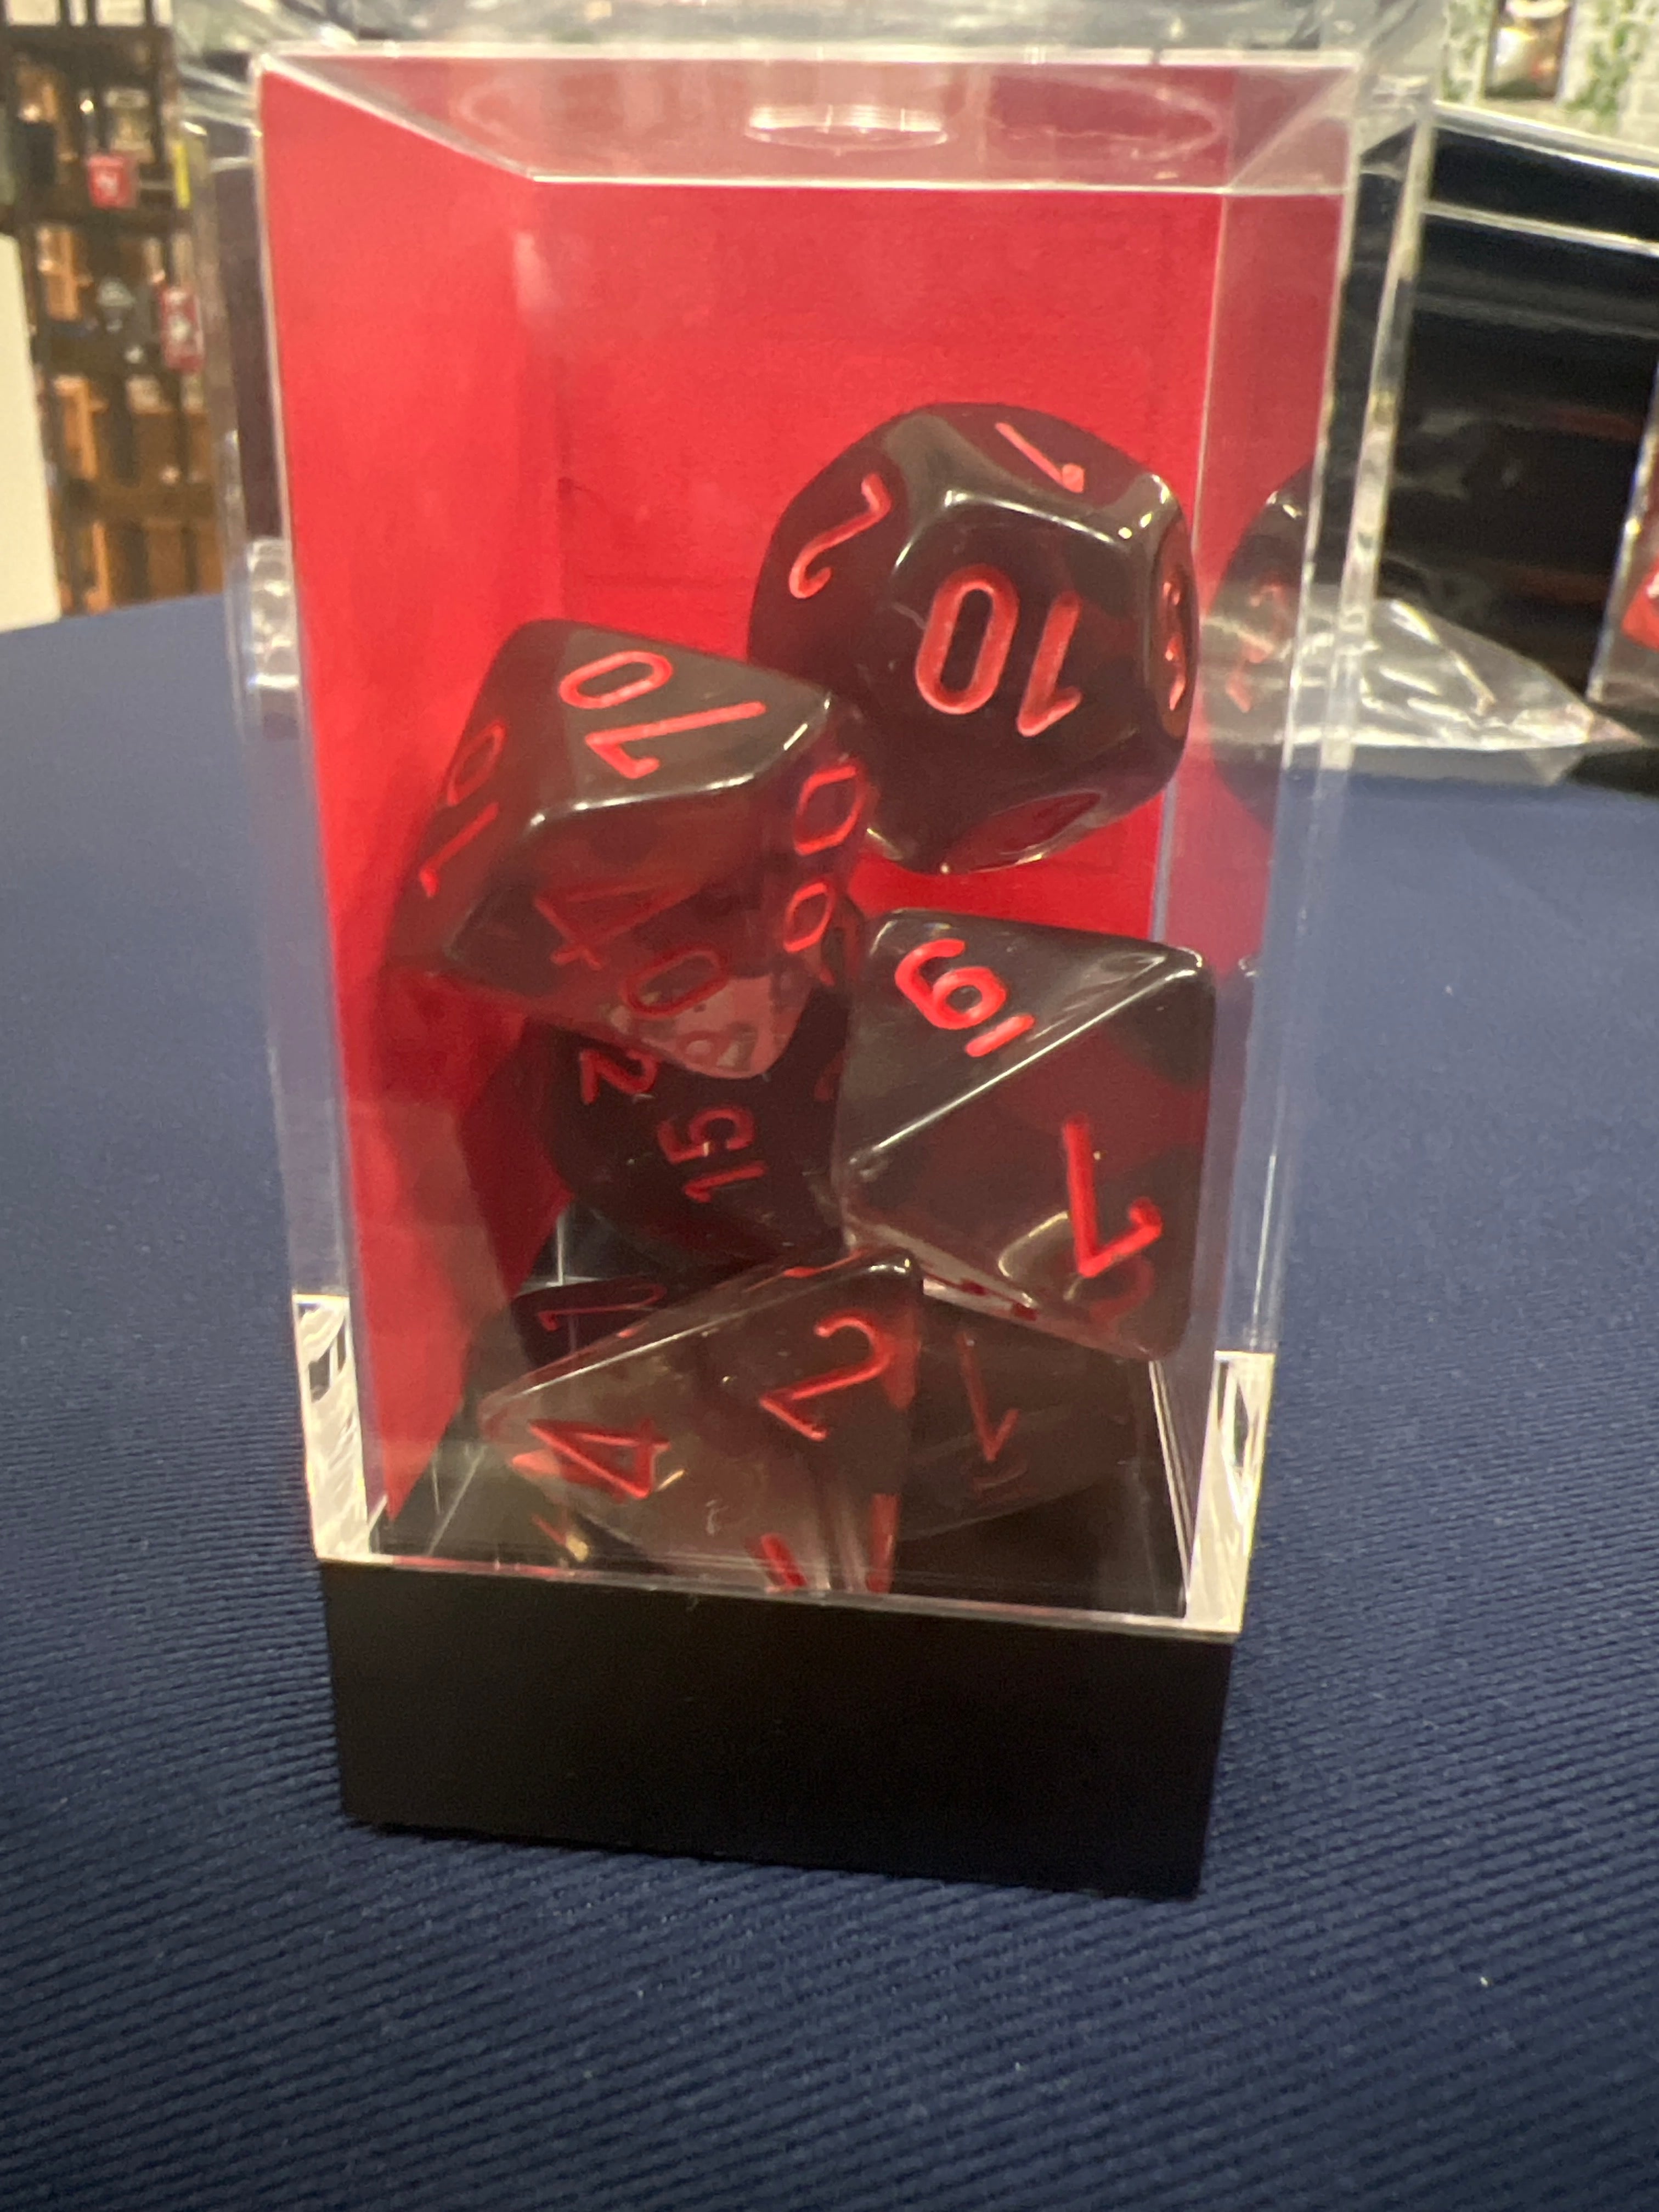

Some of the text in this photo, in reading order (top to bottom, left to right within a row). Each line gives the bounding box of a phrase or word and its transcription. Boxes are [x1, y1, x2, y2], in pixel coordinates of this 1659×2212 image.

[915, 565, 1084, 737] 10
[894, 937, 1035, 1058] 6
[658, 1104, 767, 1204] 15
[1062, 1110, 1163, 1278] 7
[759, 1311, 892, 1442] 2
